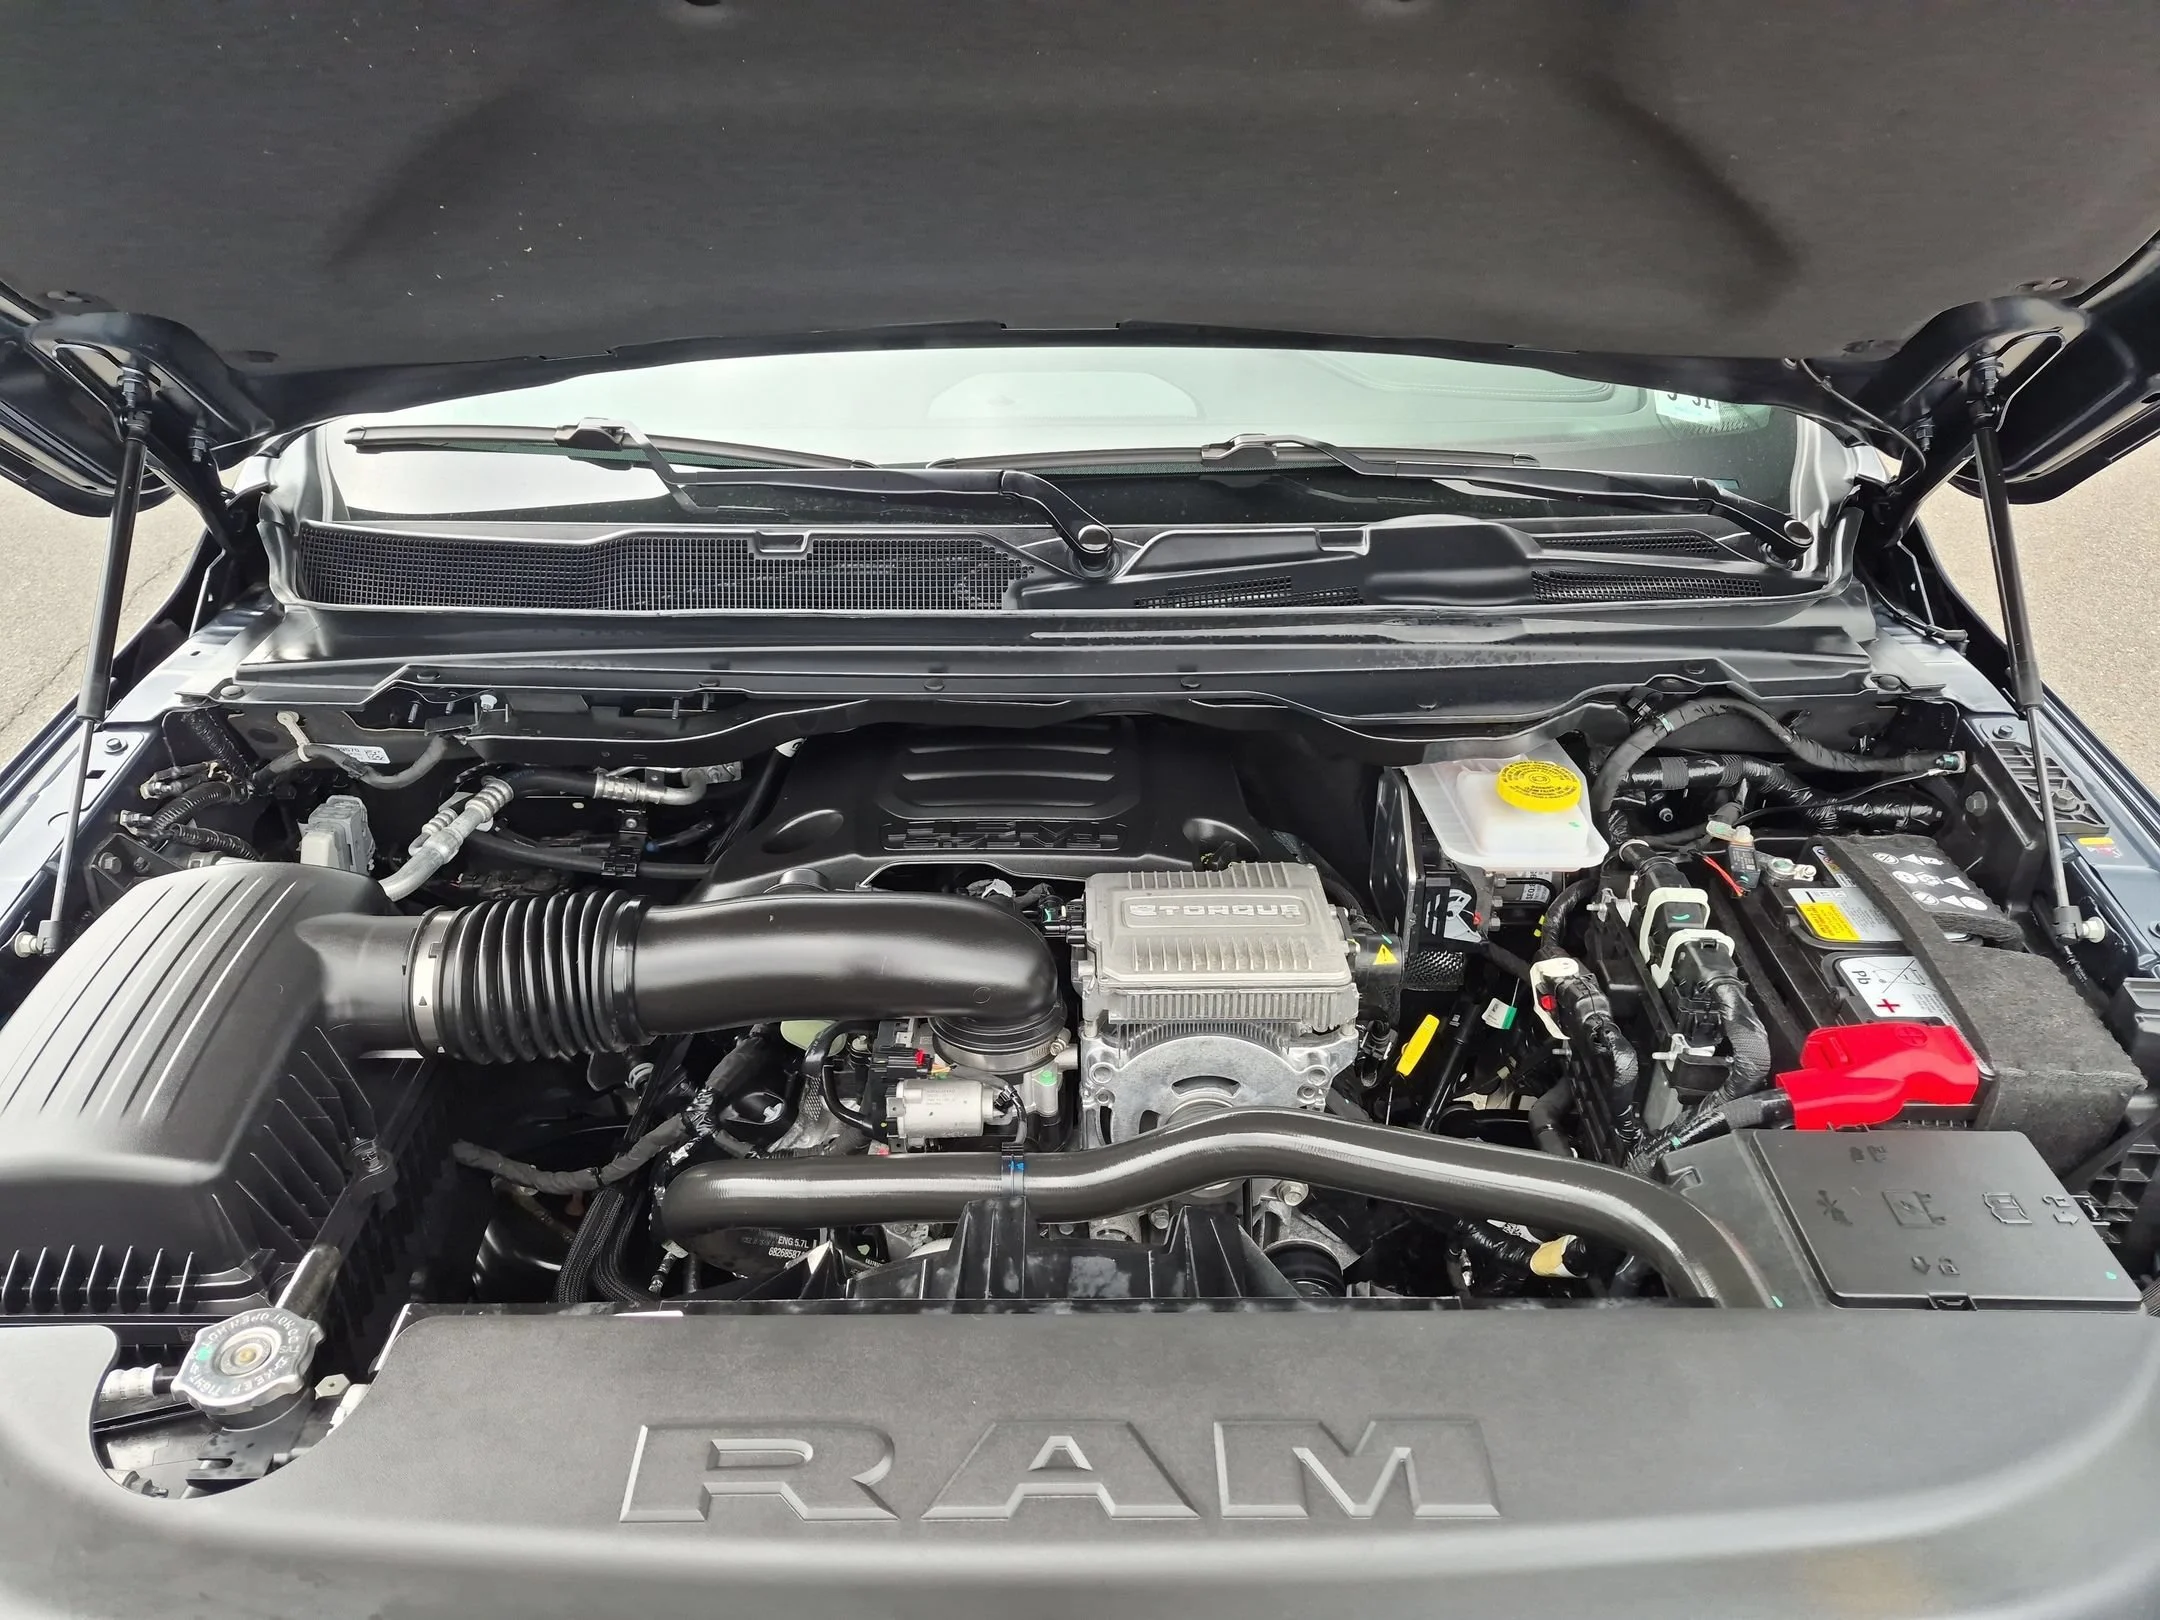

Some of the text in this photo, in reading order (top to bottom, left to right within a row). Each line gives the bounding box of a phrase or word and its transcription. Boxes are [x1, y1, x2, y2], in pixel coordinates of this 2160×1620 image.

[778, 1235, 794, 1246] ENG
[794, 1238, 809, 1249] 5.7L
[619, 1416, 1501, 1522] RAM
